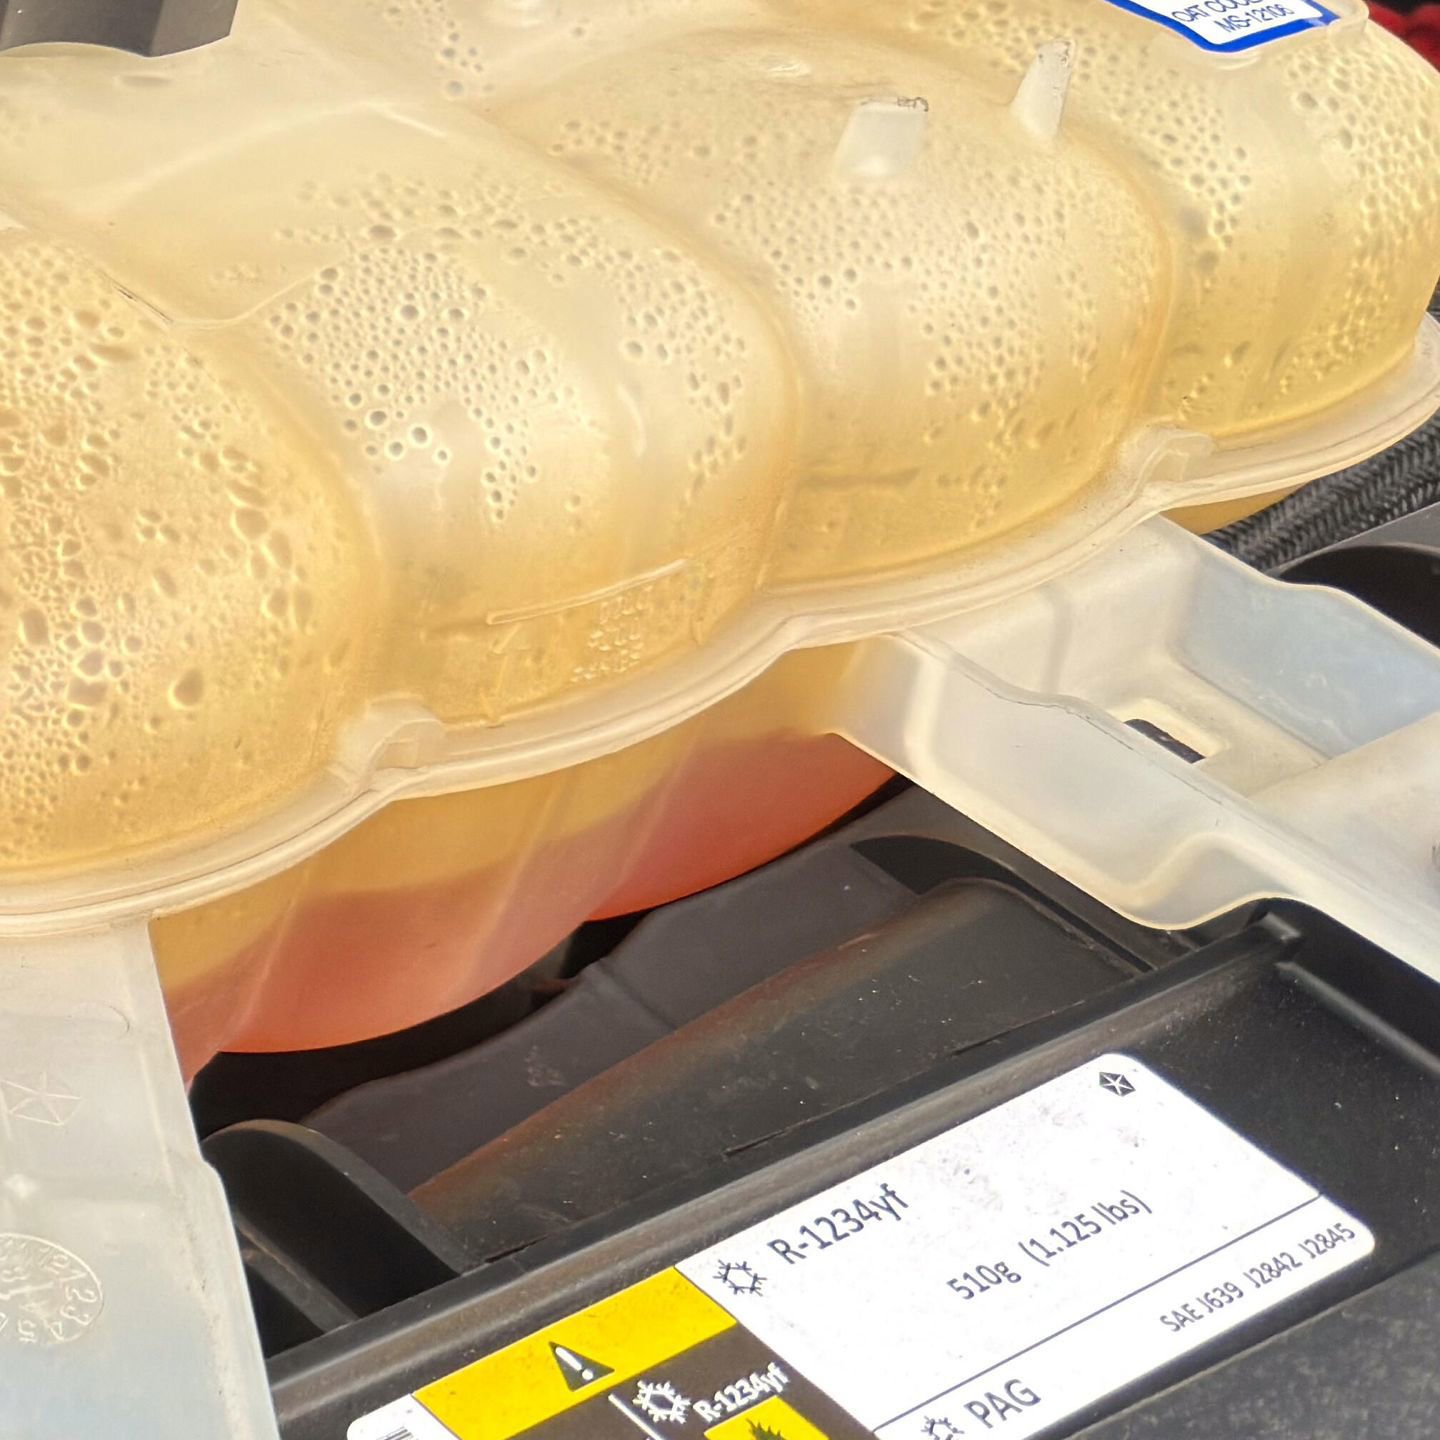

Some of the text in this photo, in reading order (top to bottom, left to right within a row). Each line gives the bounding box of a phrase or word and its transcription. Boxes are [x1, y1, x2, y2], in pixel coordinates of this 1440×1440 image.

[1171, 4, 1210, 22] OAT
[767, 1183, 909, 1265] R-1234yf
[946, 1190, 1153, 1300] 510g (1.125 lbs)
[1160, 1223, 1355, 1332] SAE J639 J2842 J2845
[692, 1362, 789, 1423] R-1234yf
[964, 1378, 1041, 1430] PAG
